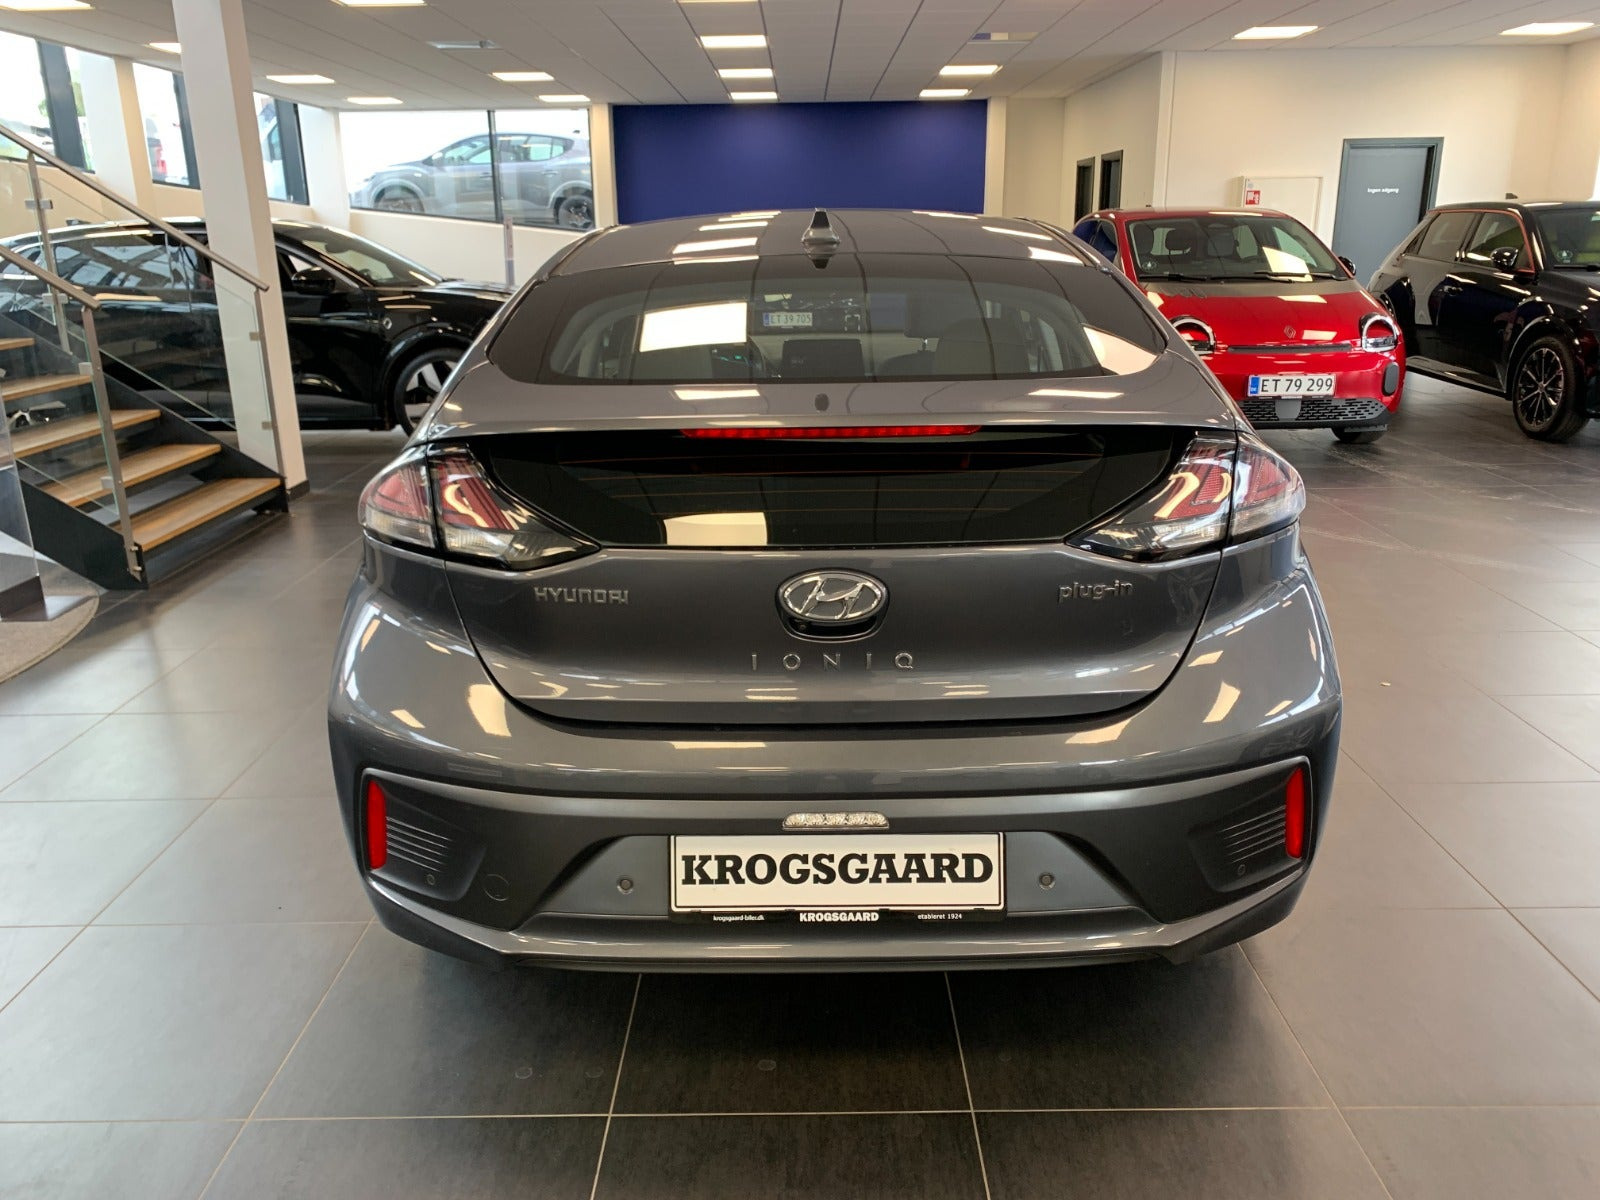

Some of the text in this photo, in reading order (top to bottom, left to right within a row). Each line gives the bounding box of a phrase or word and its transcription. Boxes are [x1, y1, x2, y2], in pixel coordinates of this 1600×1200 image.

[1261, 378, 1333, 392] ET 79 299
[534, 587, 629, 605] HYUNDAI
[1058, 580, 1133, 604] plug-in
[751, 652, 915, 671] IONIQ
[681, 852, 994, 885] KROGSGAARD
[799, 911, 880, 923] KROGSGAARD
[917, 912, 963, 920] etableret 1924
